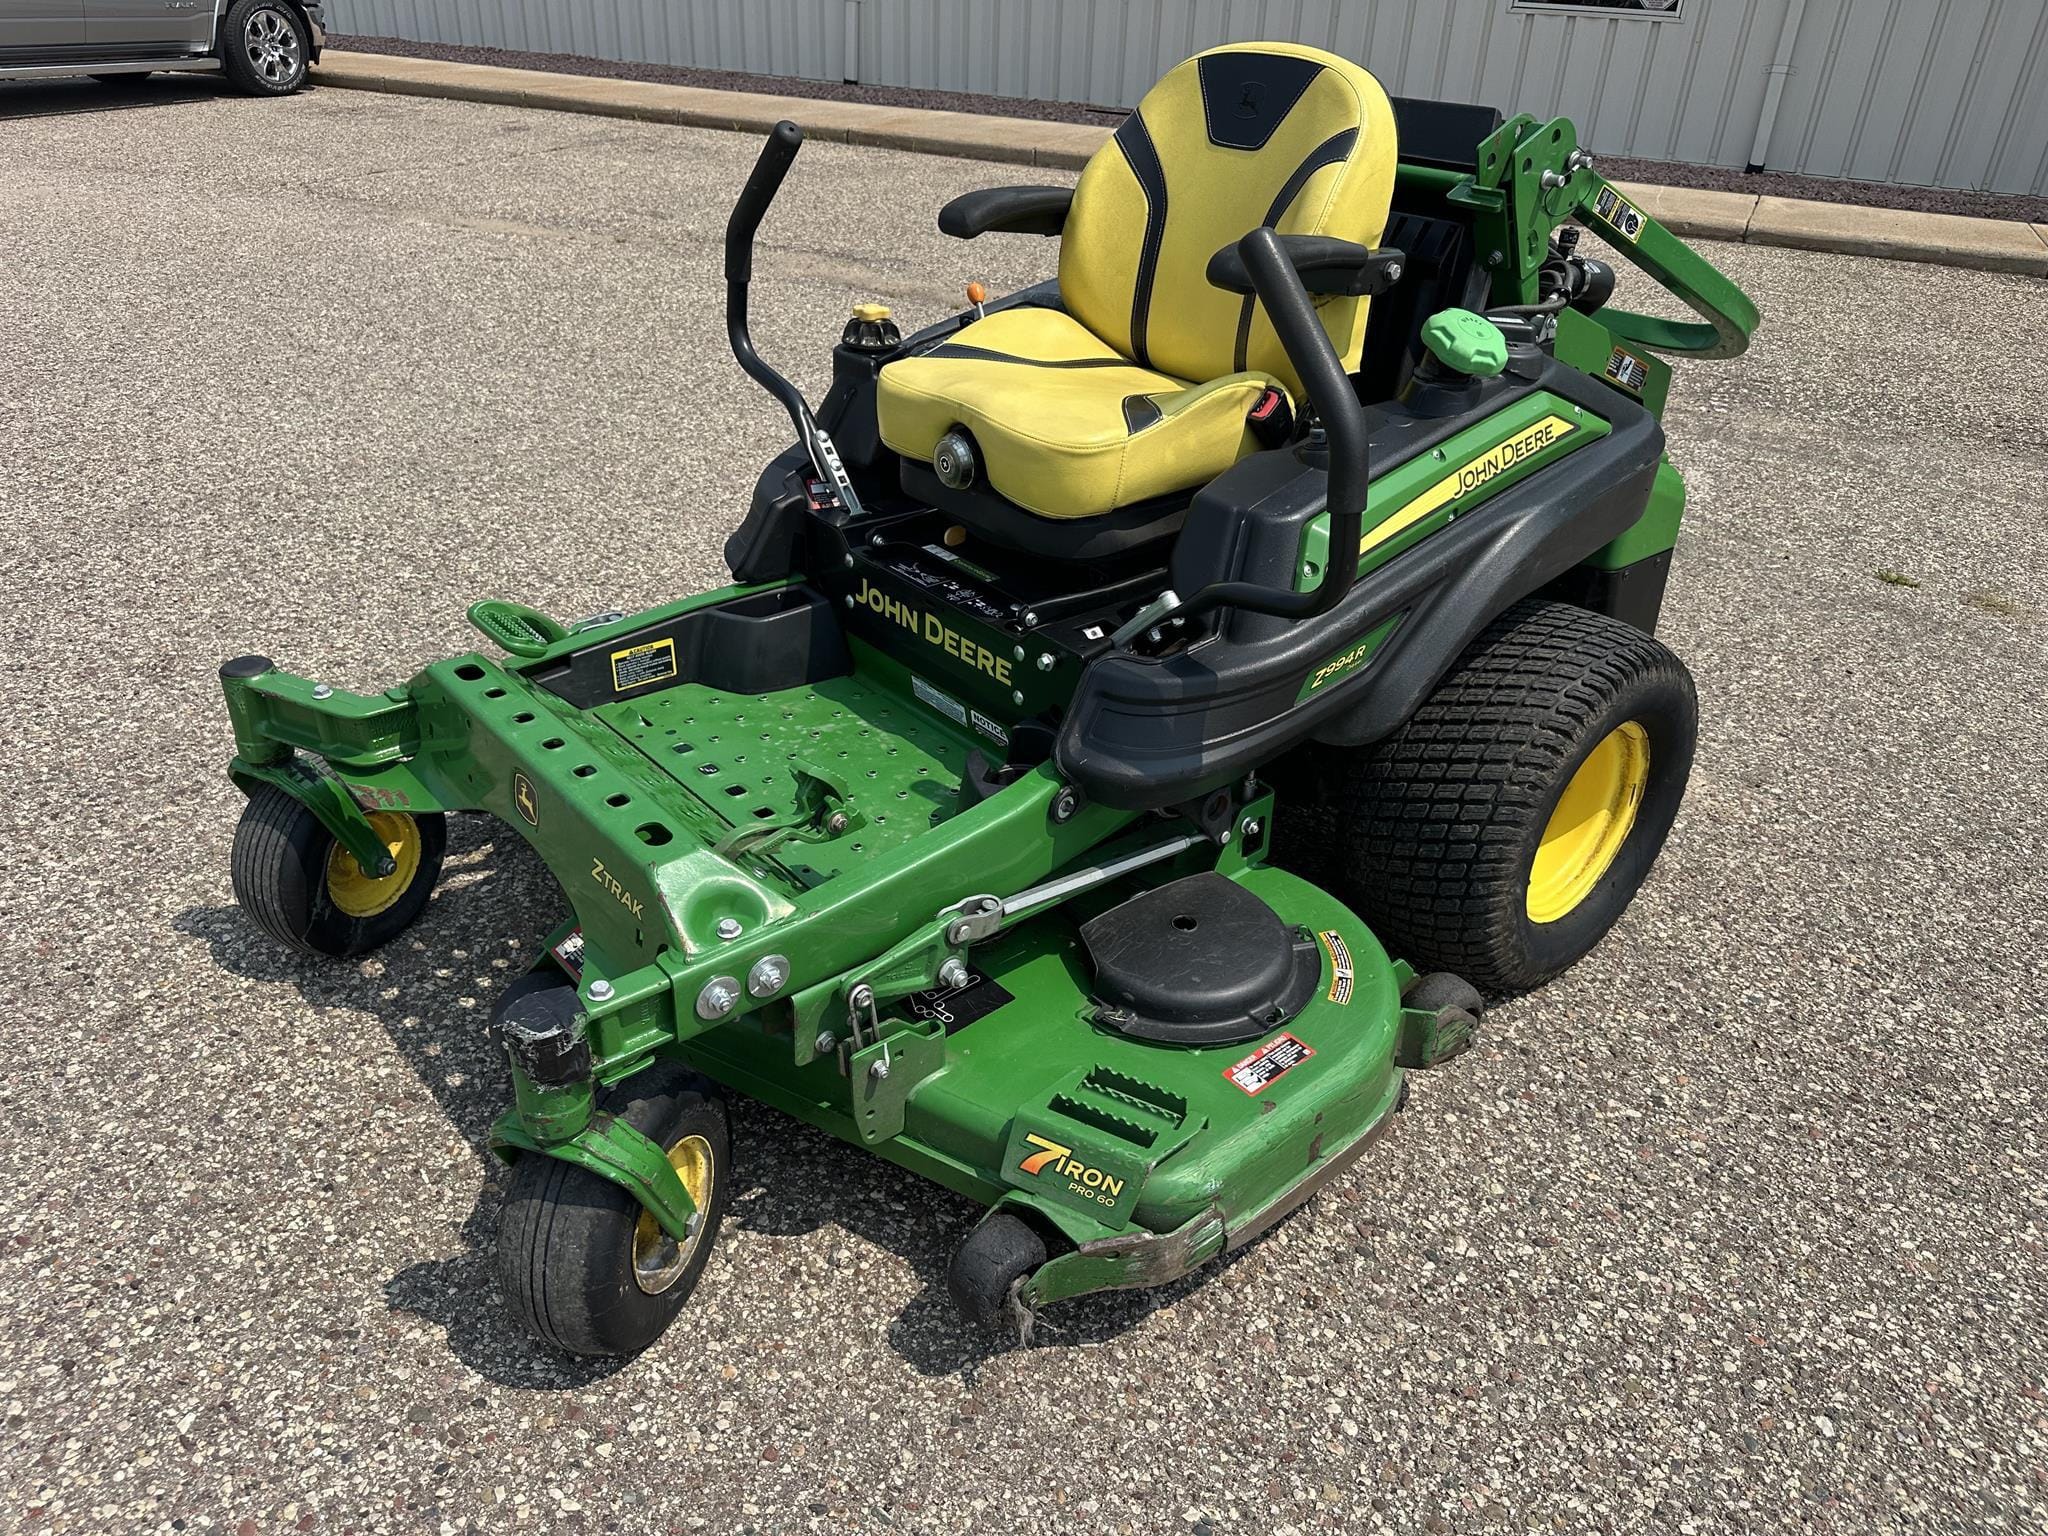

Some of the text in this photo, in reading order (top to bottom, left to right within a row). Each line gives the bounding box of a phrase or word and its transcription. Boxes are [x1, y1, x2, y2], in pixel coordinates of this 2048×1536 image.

[1454, 423, 1555, 497] JOHN DEERE
[855, 577, 918, 634] JOHN
[925, 612, 1012, 687] DEERE
[1310, 644, 1367, 689] Z994R
[973, 712, 1007, 739] NOTICE
[591, 857, 645, 920] ZTRAK
[1068, 1182, 1115, 1208] PRO 60
